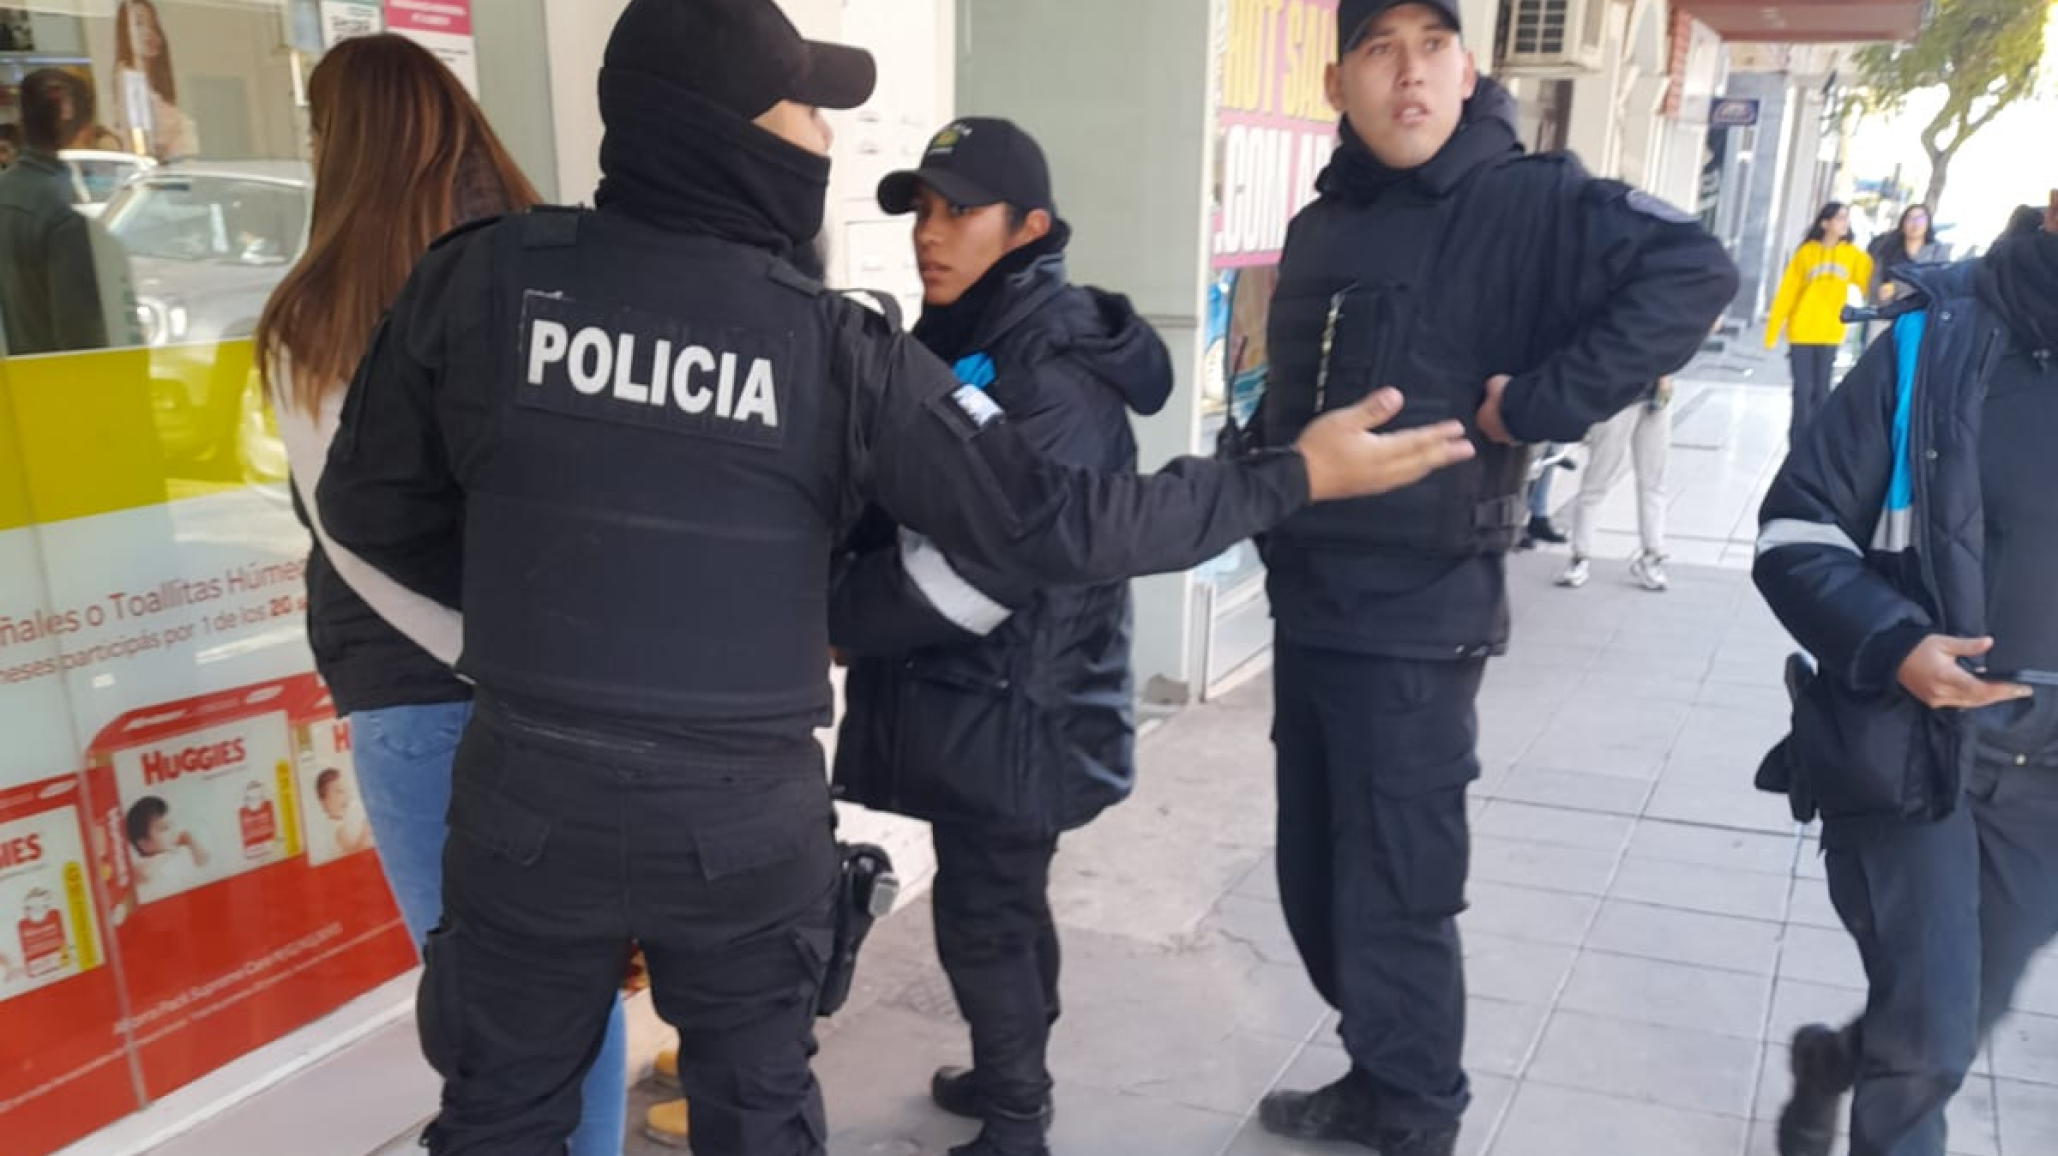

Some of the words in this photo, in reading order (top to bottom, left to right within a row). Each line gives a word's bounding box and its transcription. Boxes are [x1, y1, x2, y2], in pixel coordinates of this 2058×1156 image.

[1282, 0, 1338, 122] SAL
[527, 318, 778, 427] POLICIA
[86, 605, 104, 628] o
[107, 577, 222, 619] Toallitas
[165, 622, 195, 646] por
[215, 609, 237, 631] de
[242, 602, 267, 624] los
[140, 737, 246, 786] HUGGIES
